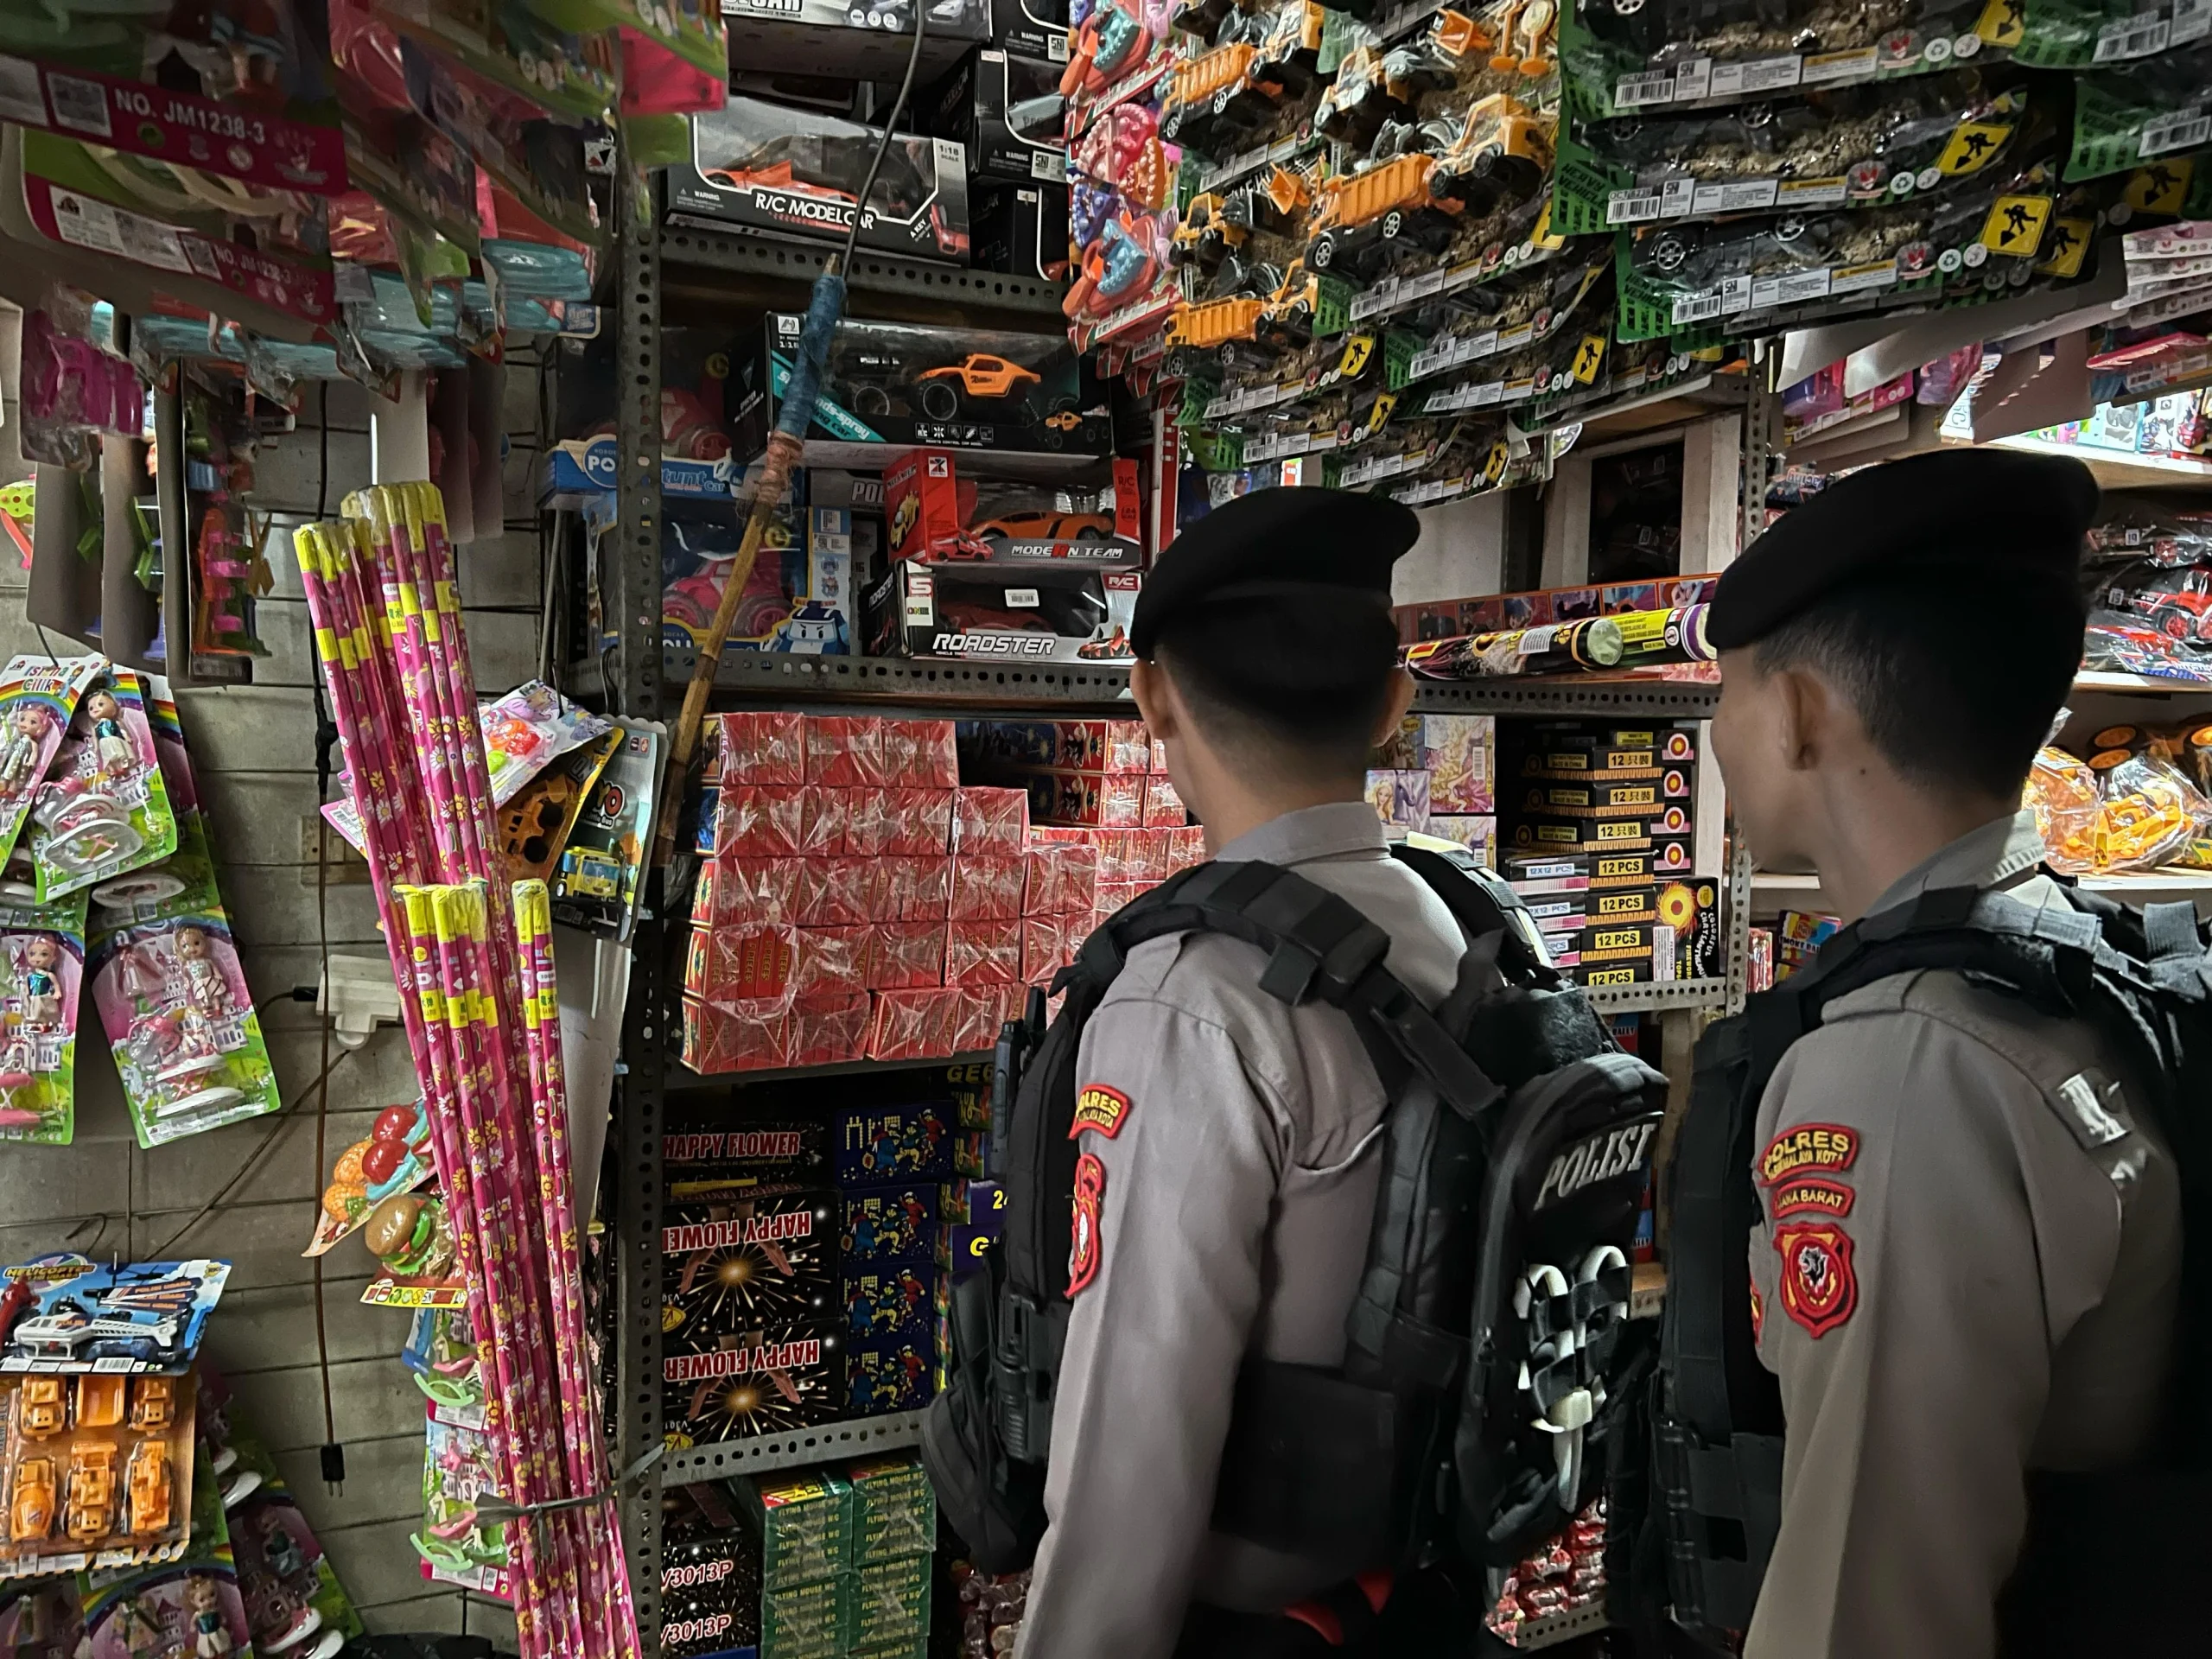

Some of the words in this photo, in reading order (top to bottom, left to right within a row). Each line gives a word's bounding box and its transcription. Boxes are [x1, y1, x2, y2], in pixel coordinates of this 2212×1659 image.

[115, 88, 156, 119] NO.
[755, 192, 785, 213] R/C
[788, 198, 843, 220] MODEL
[1011, 543, 1079, 558] MODERN
[1084, 546, 1123, 558] TEAM
[1108, 576, 1135, 587] R/C
[932, 633, 1055, 655] ROADSTER
[1611, 754, 1624, 766] 12
[1613, 791, 1625, 802] 12
[1600, 826, 1613, 837] 12
[1530, 867, 1552, 875] 12X12
[1602, 862, 1615, 874] 12
[1618, 861, 1640, 873] PCS
[1603, 899, 1616, 911] 12
[1618, 897, 1641, 909] PCS
[1599, 935, 1611, 946] 12
[1614, 933, 1637, 945] PCS
[745, 951, 755, 983] PIECES
[762, 949, 772, 982] PIECES
[779, 950, 788, 982] PIECES
[1592, 974, 1605, 985] 12
[1608, 972, 1630, 984] PCS
[662, 1134, 724, 1160] HAPPY
[727, 1132, 801, 1158] FLOWER
[1533, 1122, 1657, 1211] POLISI
[993, 1190, 1008, 1210] 2
[1800, 1189, 1843, 1209] BARAT
[744, 1211, 812, 1243] HAPPY
[753, 1338, 821, 1371] HAPPY
[664, 1348, 748, 1382] FLOWER
[866, 1478, 888, 1491] FLYING
[890, 1473, 911, 1484] MOUSE
[861, 1565, 883, 1576] FLYING
[886, 1560, 907, 1572] MOUSE
[774, 1590, 798, 1601] FLYING
[800, 1585, 822, 1597] MOUSE
